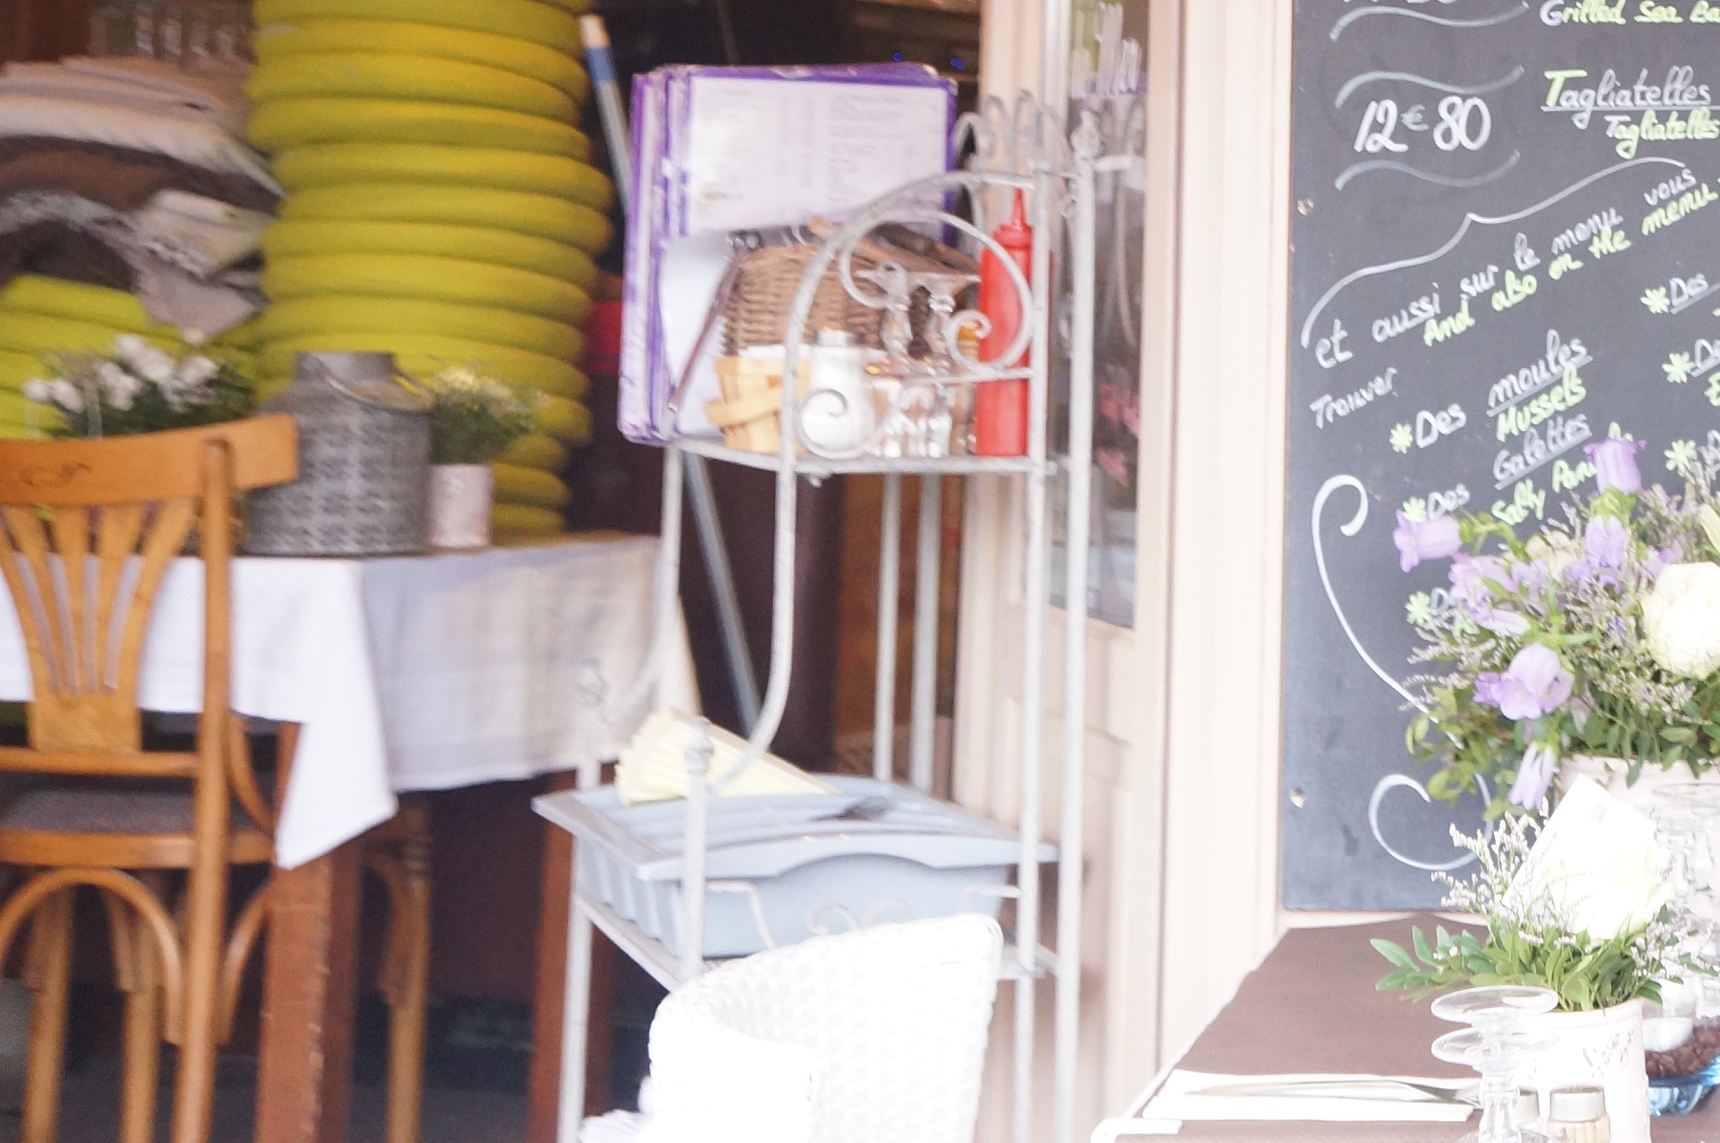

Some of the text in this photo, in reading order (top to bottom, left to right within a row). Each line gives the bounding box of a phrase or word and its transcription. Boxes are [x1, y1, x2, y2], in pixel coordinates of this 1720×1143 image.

[1634, 0, 1684, 24] Sea
[1544, 65, 1711, 130] Tagliatelles
[1604, 107, 1720, 159] Tagliatelles
[1315, 168, 1698, 369] et aussi sur le menu vous
[1423, 299, 1476, 346] And
[1491, 269, 1538, 312] also
[1548, 252, 1584, 280] on
[1588, 228, 1632, 260] the
[1670, 273, 1709, 306] Des
[1415, 403, 1467, 449] Des
